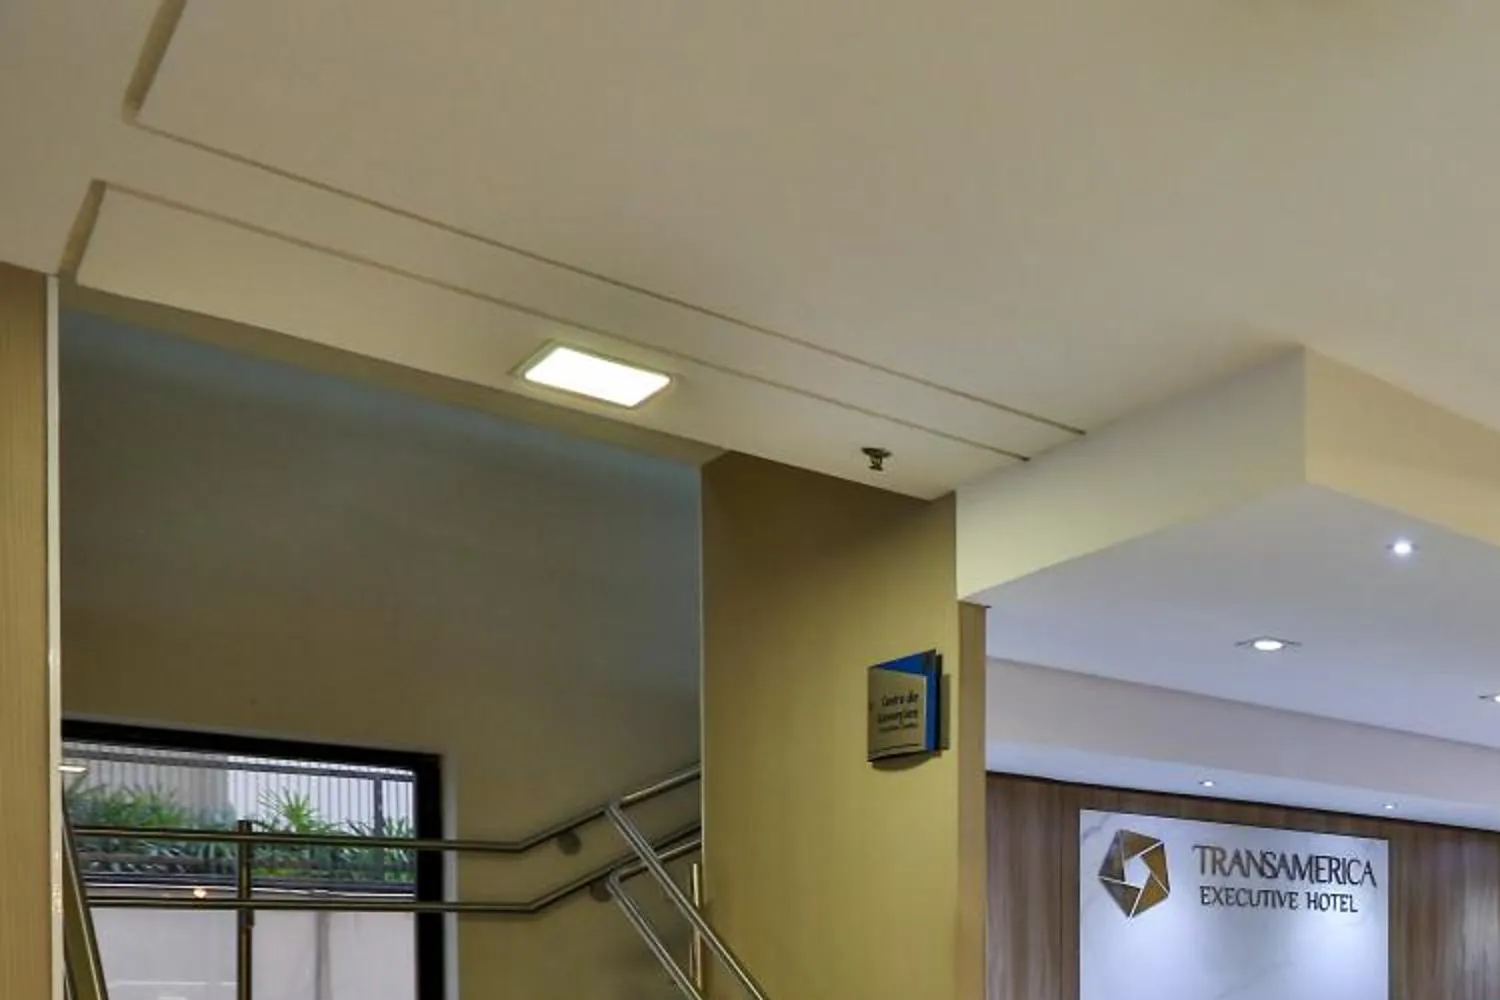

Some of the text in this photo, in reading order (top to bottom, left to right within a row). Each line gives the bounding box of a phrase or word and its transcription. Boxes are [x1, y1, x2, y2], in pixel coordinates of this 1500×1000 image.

[1192, 845, 1376, 888] TRANSAMERICA
[1199, 886, 1358, 913] EXECUTIVE HOTEL
